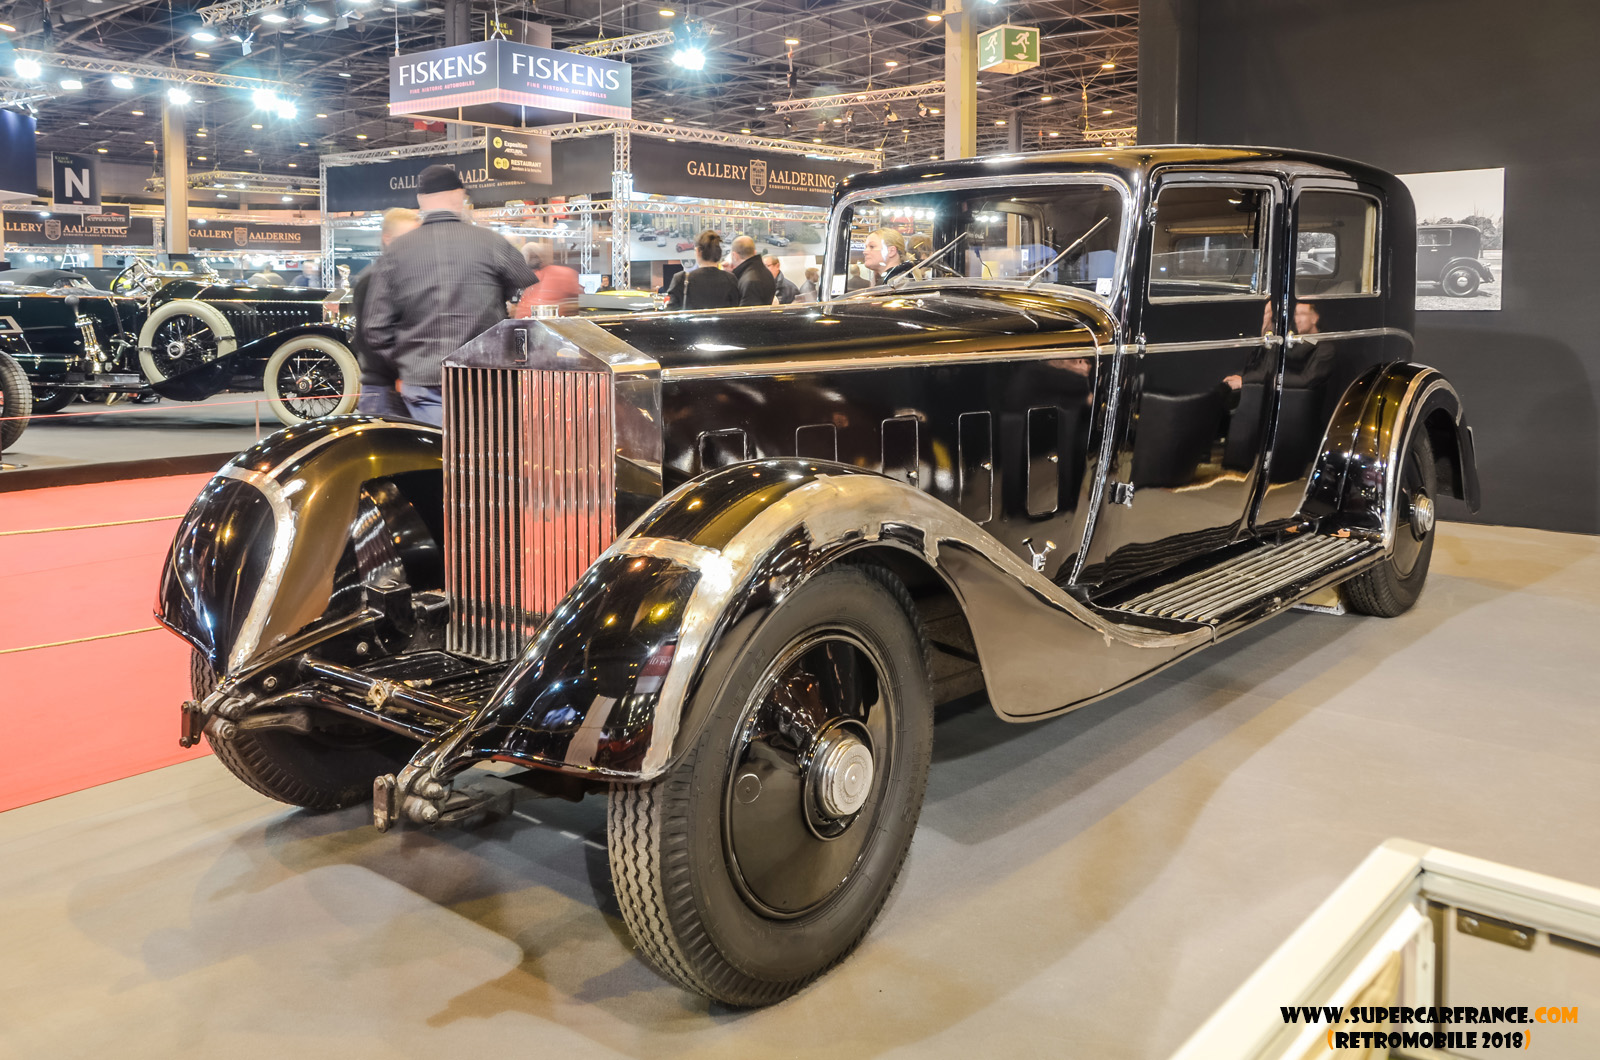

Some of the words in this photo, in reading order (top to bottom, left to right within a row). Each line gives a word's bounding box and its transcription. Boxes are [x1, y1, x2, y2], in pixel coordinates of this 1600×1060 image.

[399, 52, 487, 86] FISKENS
[512, 53, 620, 91] FISKENS
[526, 81, 540, 89] FINE
[543, 84, 569, 93] HISTORIC
[571, 89, 607, 99] AUTOMOBILES
[510, 159, 542, 168] RESTAURANT
[687, 160, 748, 181] GALLERY
[768, 169, 836, 189] AALDERING
[64, 167, 90, 199] N
[389, 174, 424, 190] GALLE
[458, 168, 489, 184] AALD
[188, 229, 233, 239] GALLERY
[249, 231, 301, 241] AALDERING
